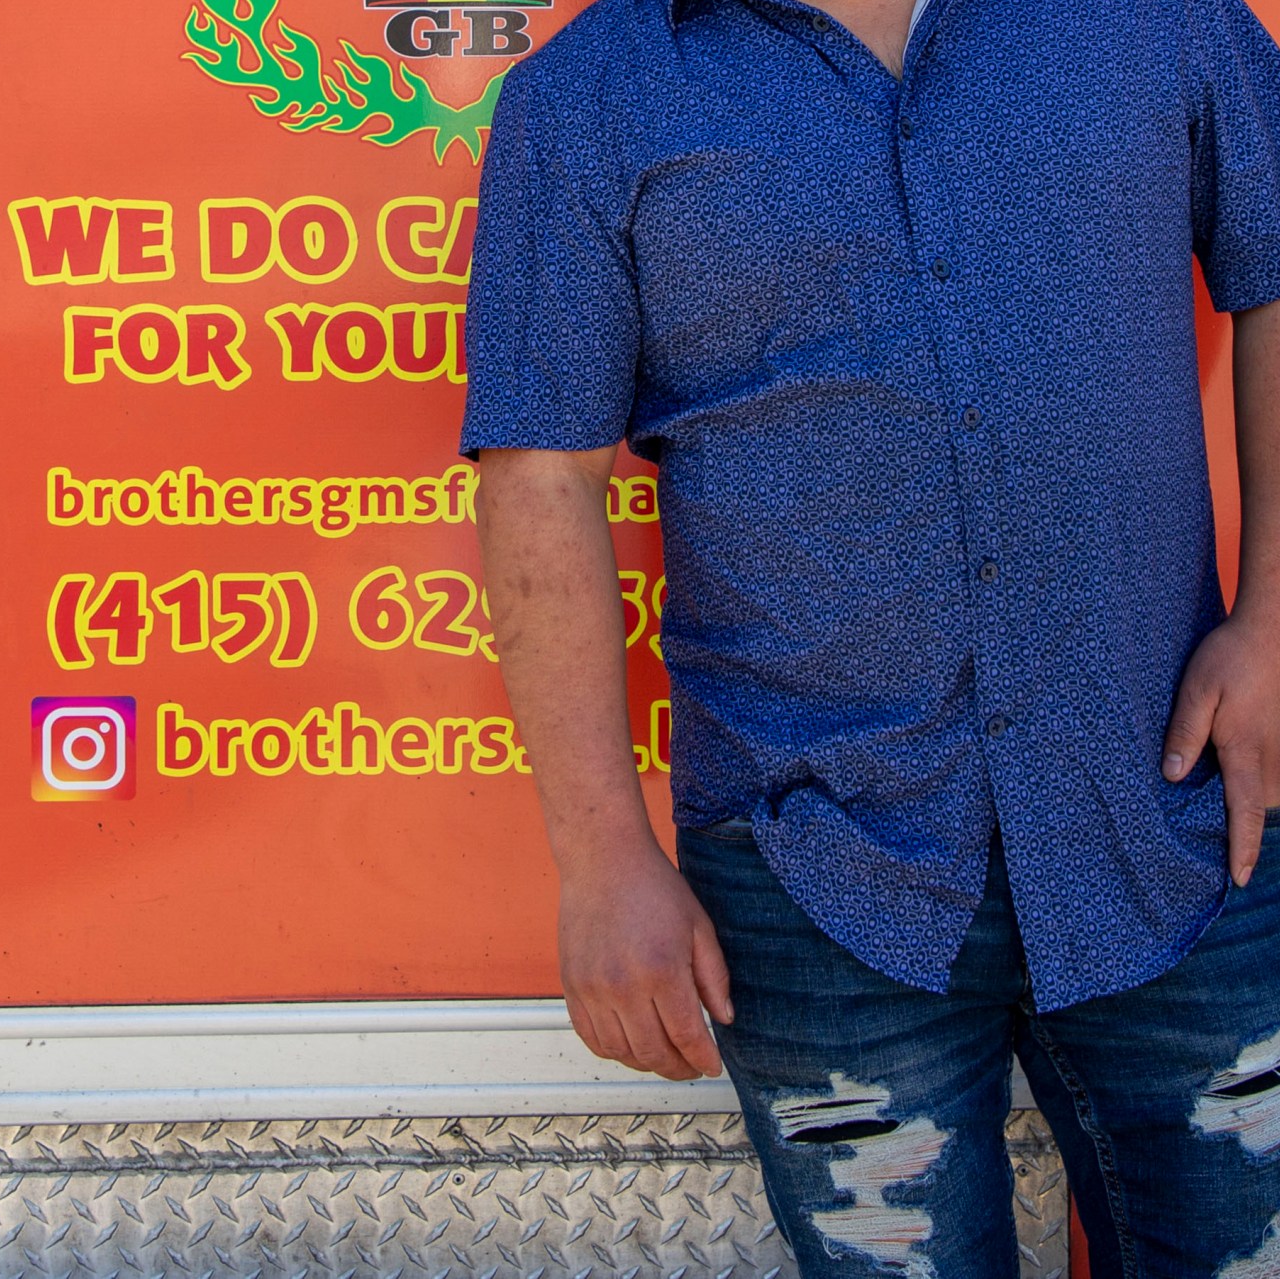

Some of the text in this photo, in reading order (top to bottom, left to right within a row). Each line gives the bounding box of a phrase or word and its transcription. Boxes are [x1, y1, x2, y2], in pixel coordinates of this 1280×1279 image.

[386, 10, 533, 58] GB
[7, 195, 177, 287] WE
[199, 194, 359, 285] DO
[62, 302, 253, 392] FOR
[46, 569, 319, 671] (415)
